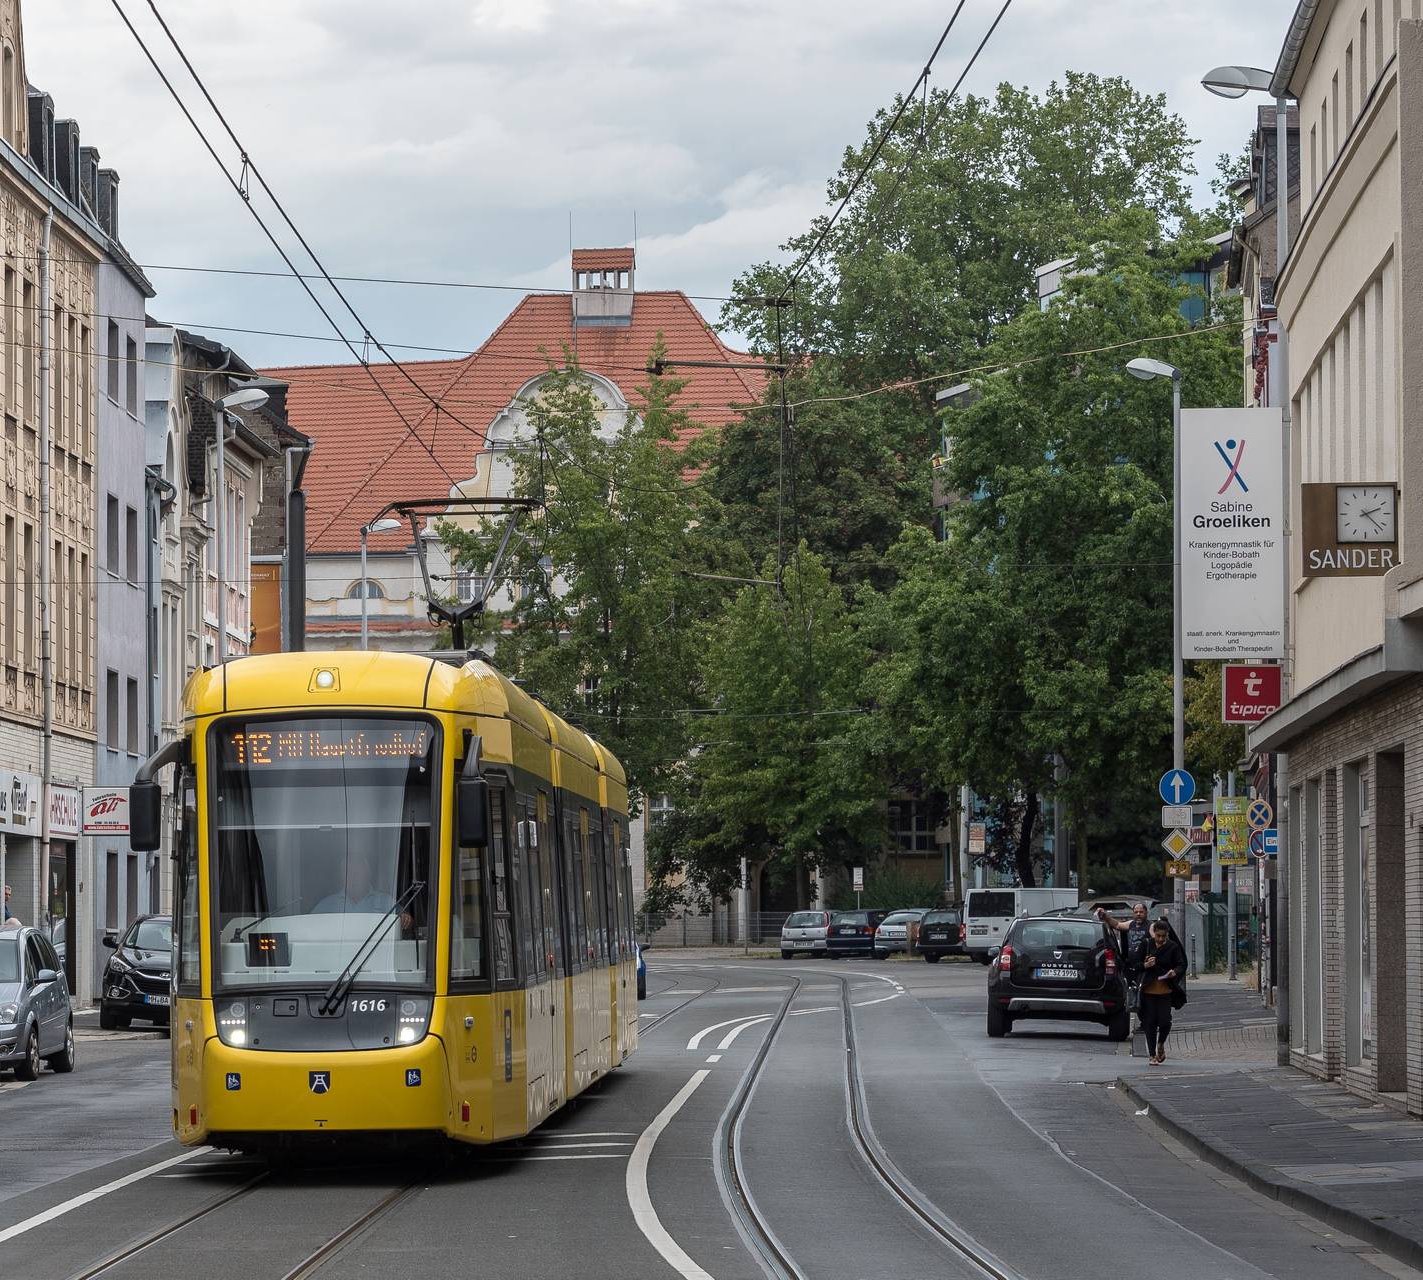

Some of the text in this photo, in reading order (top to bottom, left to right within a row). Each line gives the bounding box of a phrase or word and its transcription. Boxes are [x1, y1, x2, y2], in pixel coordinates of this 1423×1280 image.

[1210, 501, 1253, 513] Sabine
[1192, 514, 1271, 529] Groeliken
[1188, 540, 1275, 550] Krankengymnastik für
[1203, 551, 1260, 559] Kinder-Bobath
[1309, 548, 1394, 570] SANDER
[1211, 561, 1253, 571] Logopädie
[1206, 571, 1257, 580] Ergotherapie
[1230, 701, 1275, 717] tipico
[351, 999, 386, 1012] 1616
